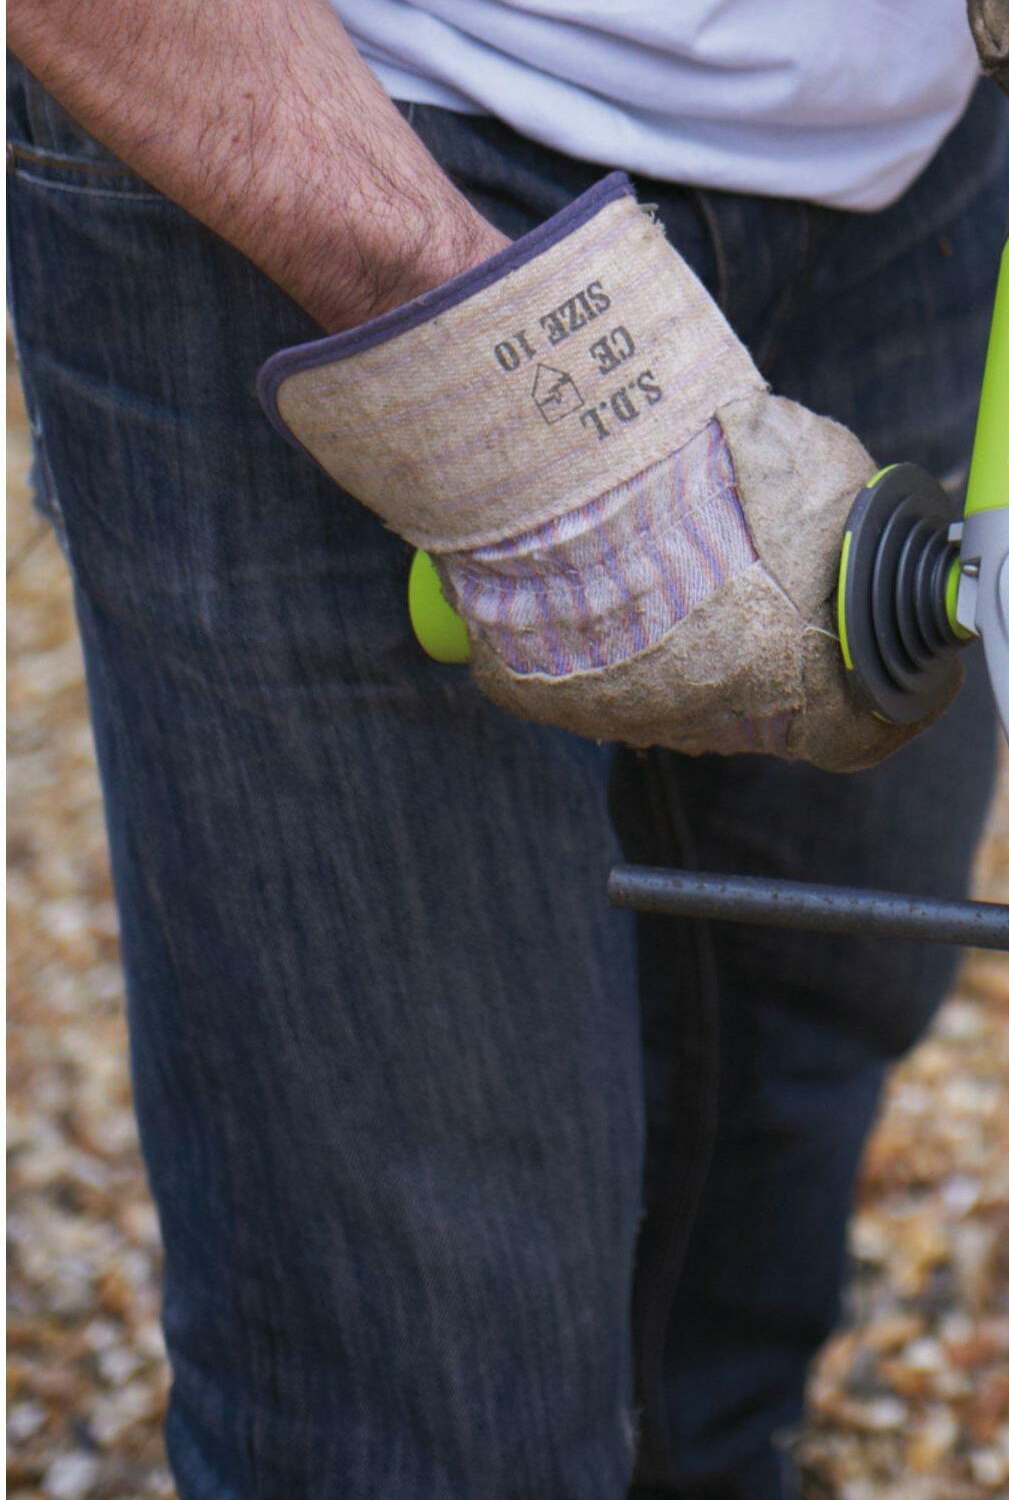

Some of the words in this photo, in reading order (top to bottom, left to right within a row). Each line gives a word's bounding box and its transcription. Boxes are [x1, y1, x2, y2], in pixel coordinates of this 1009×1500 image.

[538, 280, 611, 346] SIZE
[494, 329, 537, 373] 10
[588, 325, 637, 376] CE
